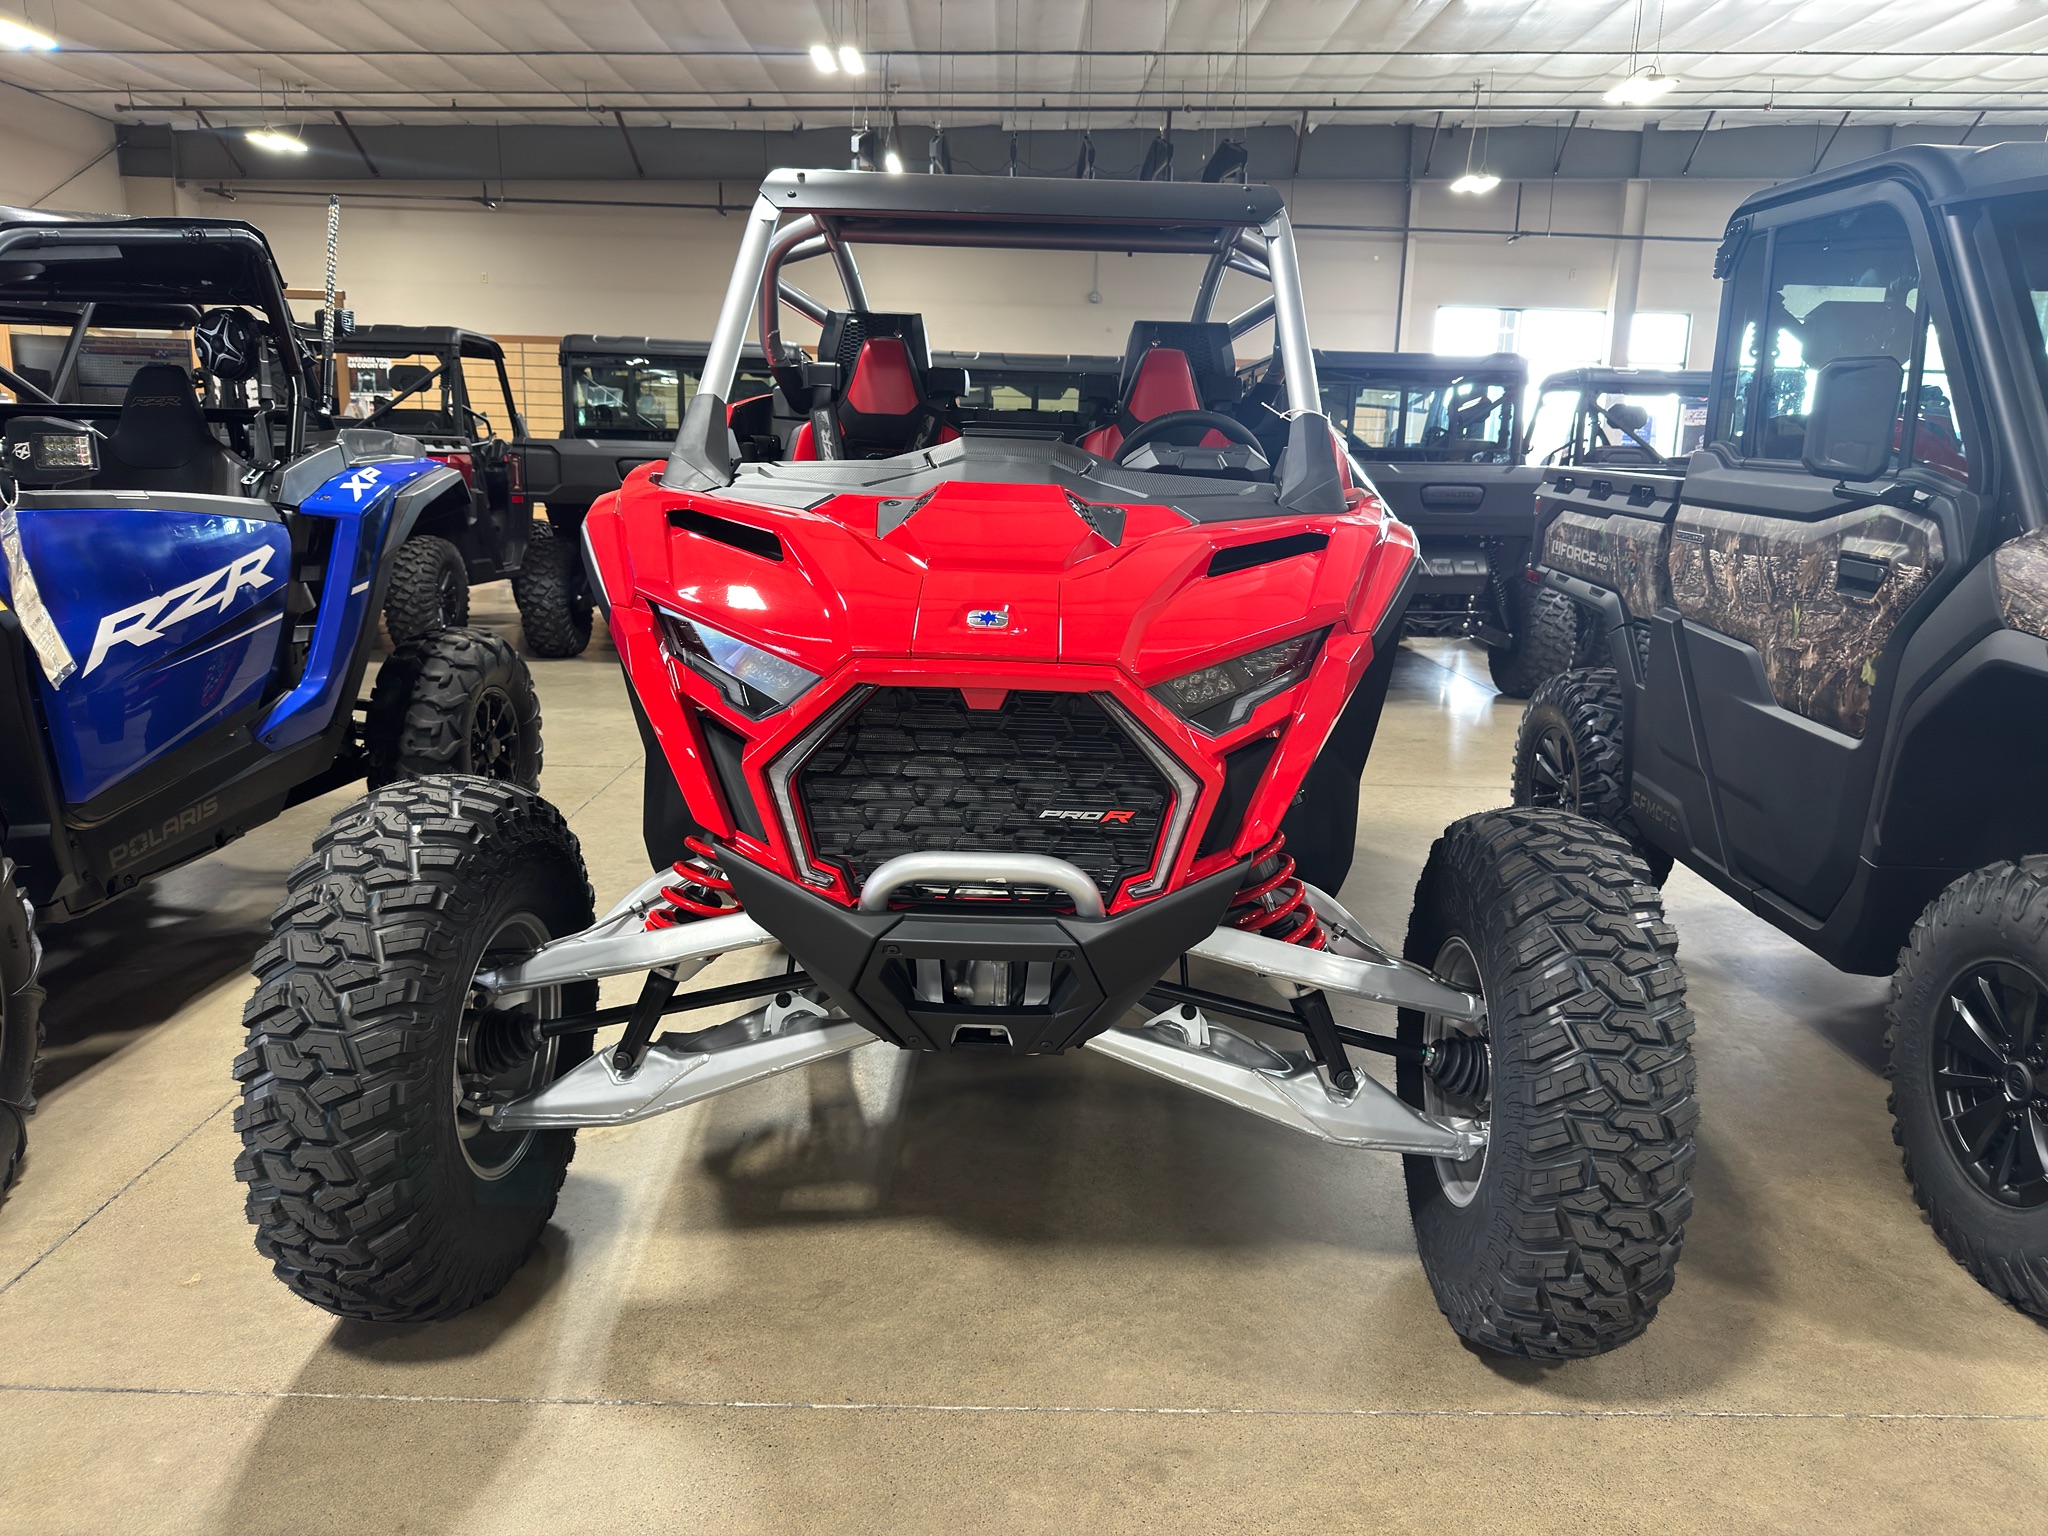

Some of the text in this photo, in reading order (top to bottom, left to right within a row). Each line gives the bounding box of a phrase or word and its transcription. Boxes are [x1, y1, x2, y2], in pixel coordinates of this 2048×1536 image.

[339, 466, 382, 502] XP
[82, 544, 276, 679] RZR
[108, 796, 219, 869] POLARIS
[1632, 790, 1678, 832] CFMOTO
